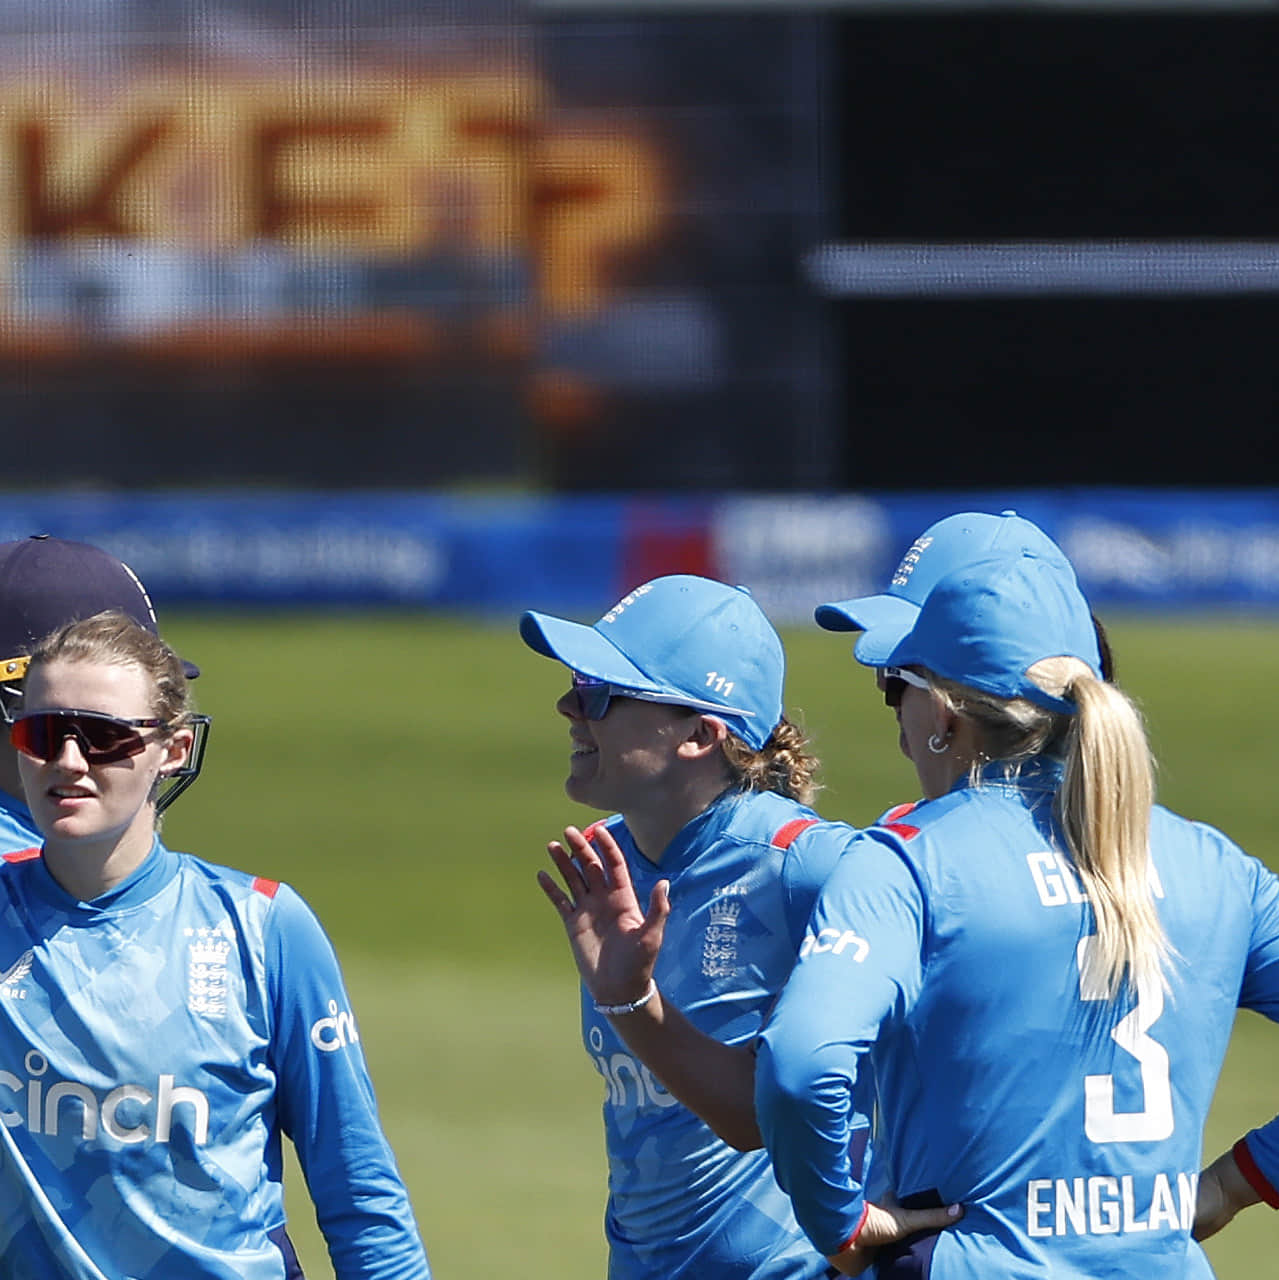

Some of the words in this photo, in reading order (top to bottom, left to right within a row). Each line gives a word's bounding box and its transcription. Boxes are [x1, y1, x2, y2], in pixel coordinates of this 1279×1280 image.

[705, 671, 735, 697] 111
[1076, 935, 1175, 1144] 3
[1027, 1172, 1200, 1238] ENGLAN
